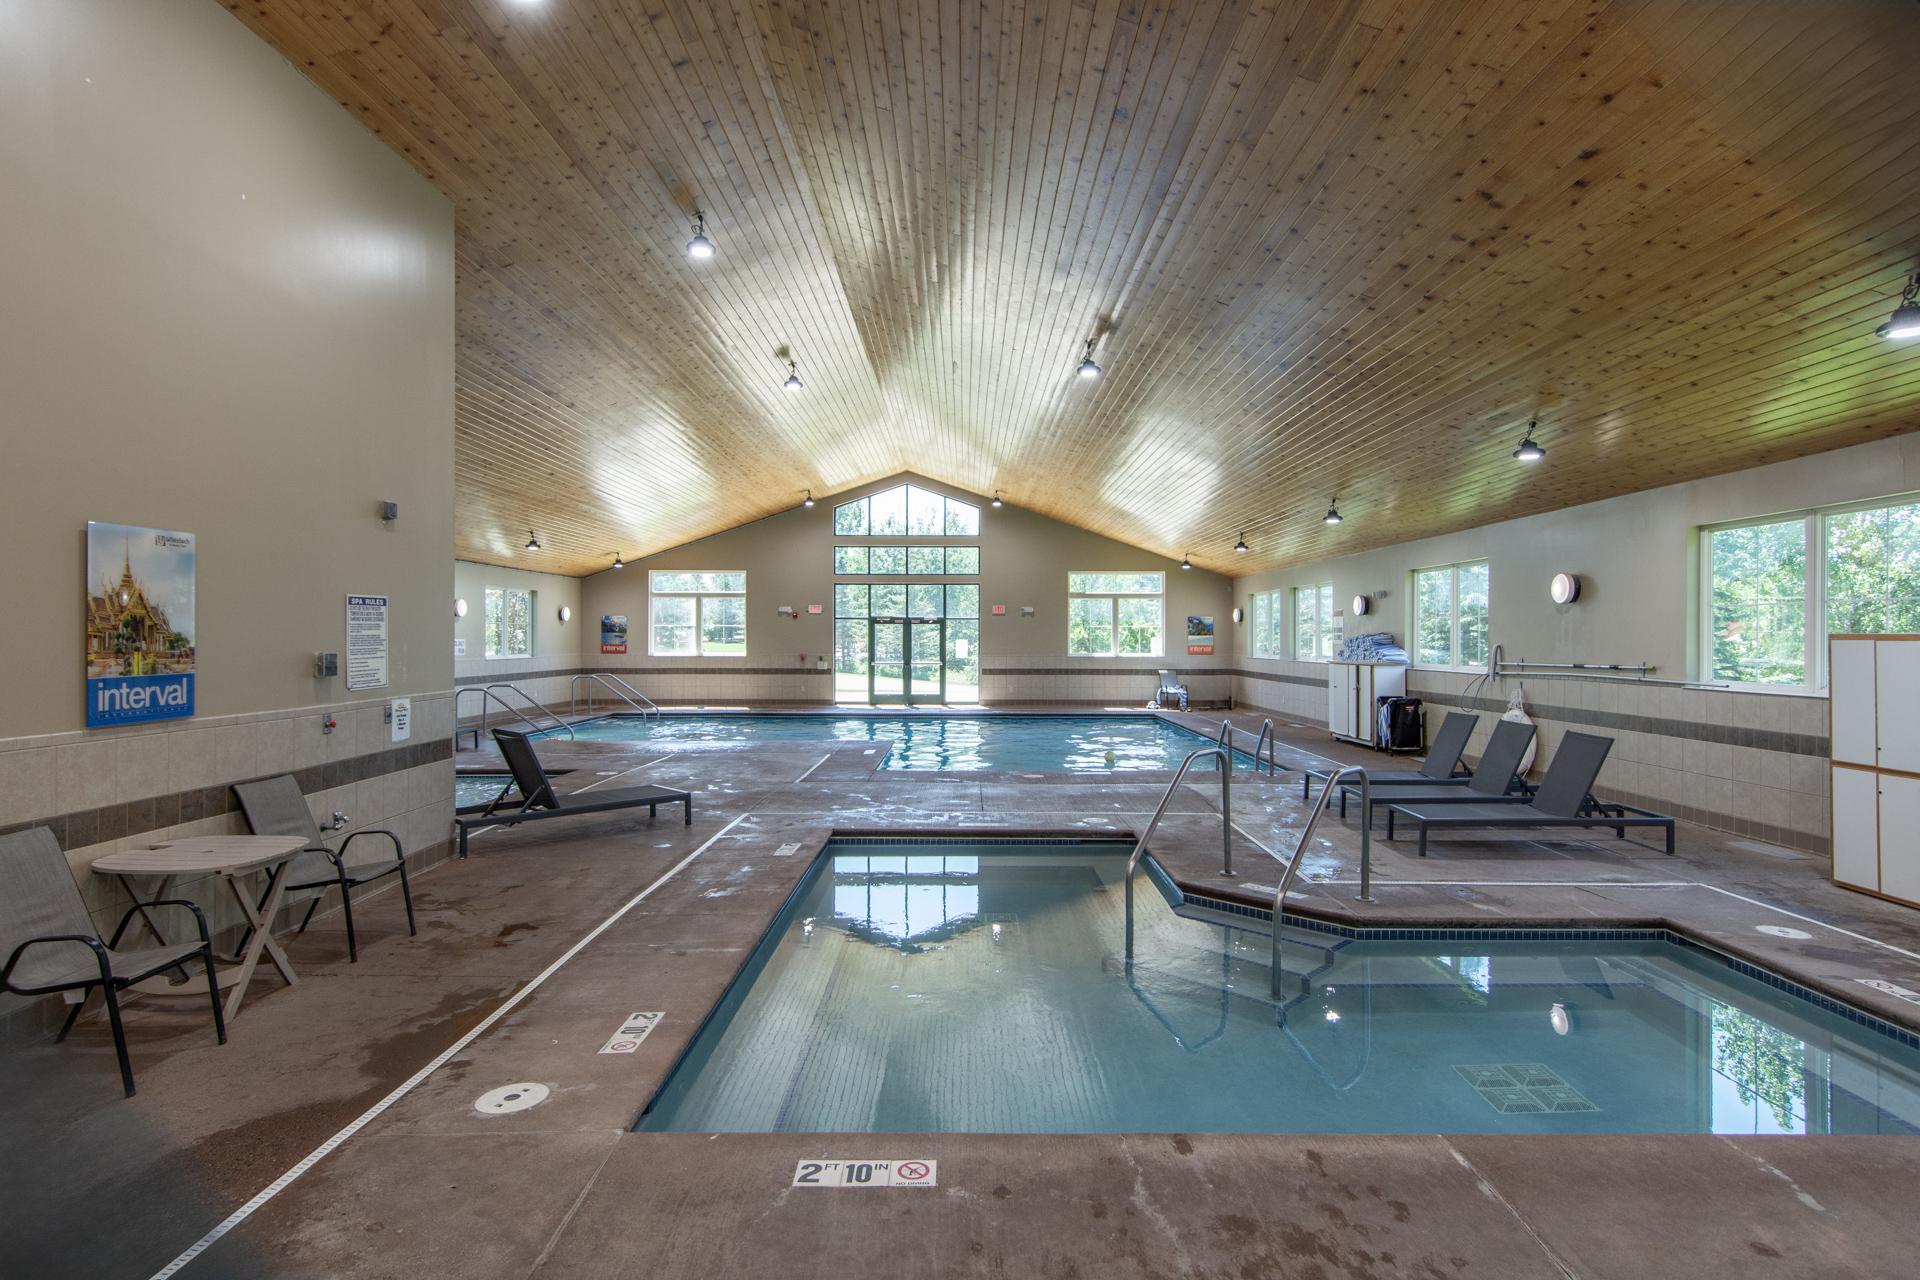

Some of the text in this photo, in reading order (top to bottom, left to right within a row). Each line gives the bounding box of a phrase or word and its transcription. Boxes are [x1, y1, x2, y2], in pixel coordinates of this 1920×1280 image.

[365, 598, 384, 606] RULES
[98, 678, 187, 711] interval
[797, 1163, 823, 1183] 2
[824, 1163, 840, 1171] FT
[846, 1163, 872, 1183] 10
